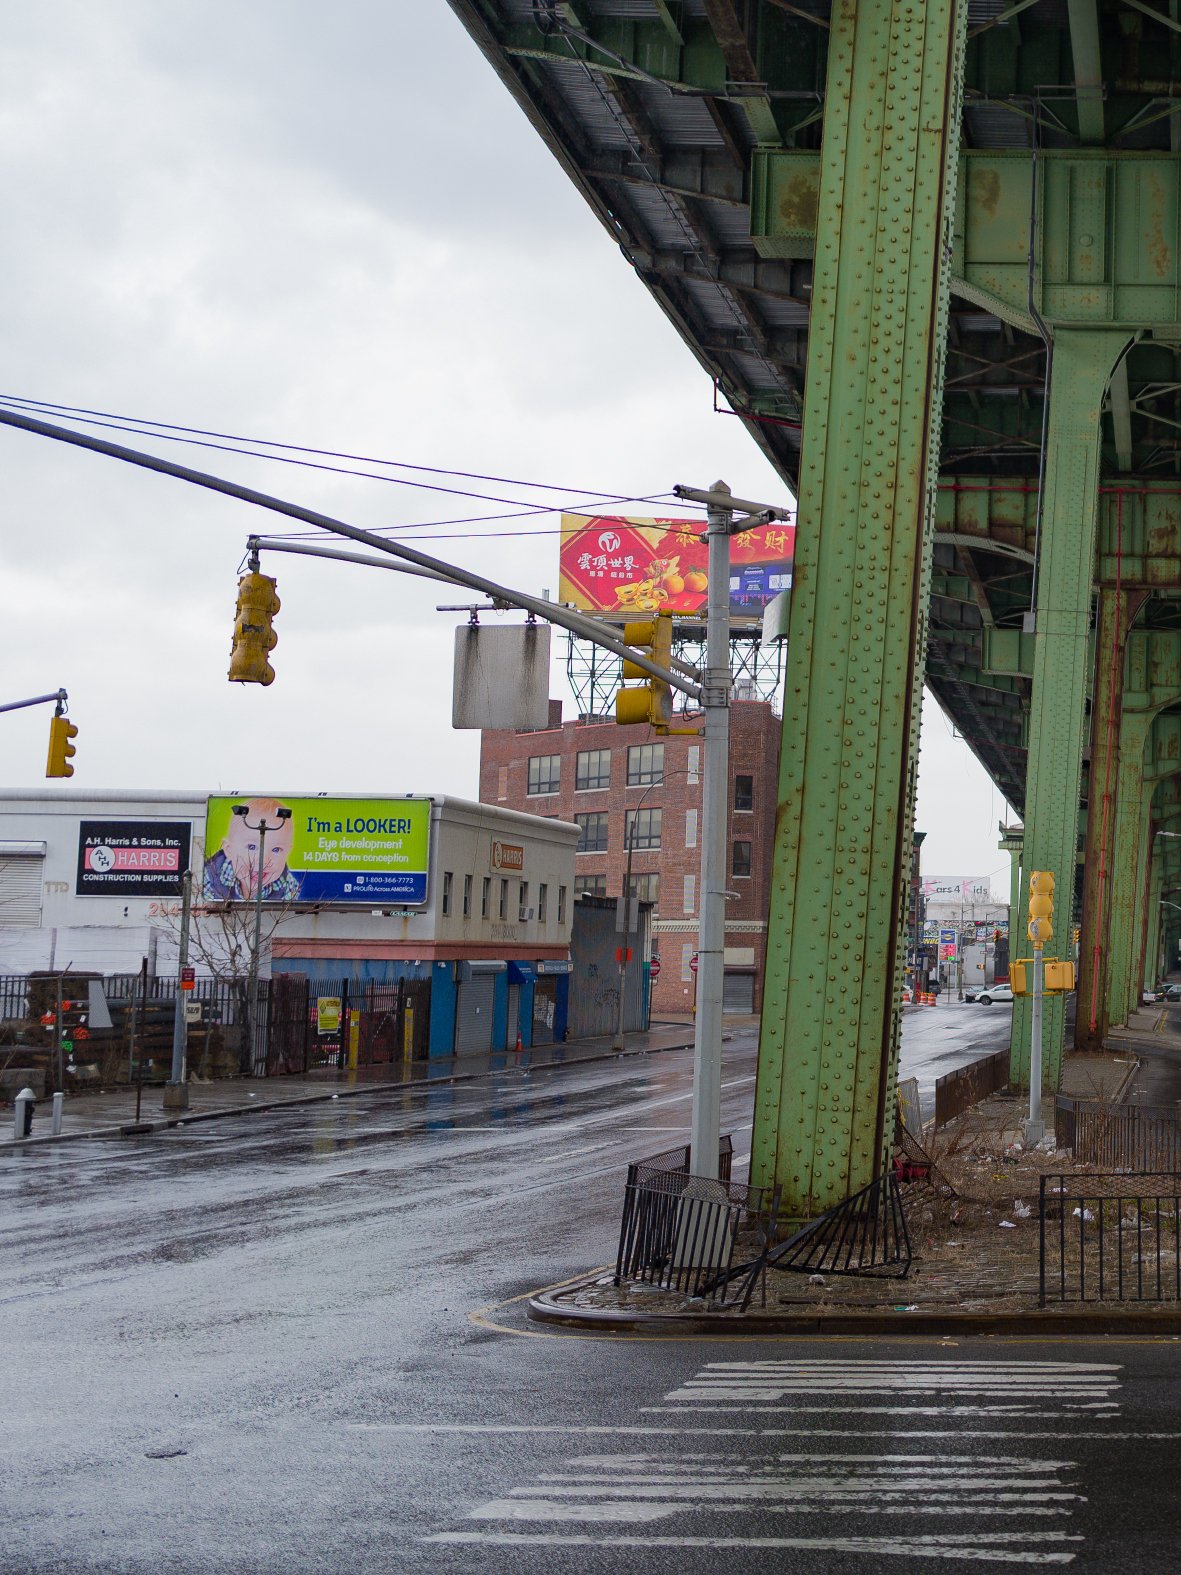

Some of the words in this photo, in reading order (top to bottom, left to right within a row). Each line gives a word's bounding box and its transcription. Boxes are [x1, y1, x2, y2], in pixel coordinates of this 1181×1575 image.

[577, 552, 640, 570] 雲頂世界
[306, 817, 331, 833] I'm
[334, 822, 343, 833] a
[346, 818, 412, 834] LOOKER!
[85, 837, 103, 845] A.H.
[104, 837, 130, 846] Harris
[131, 838, 139, 846] &
[140, 838, 164, 847] Sons,
[165, 838, 182, 846] Inc.
[318, 837, 337, 851] Eye
[339, 837, 403, 851] development
[117, 851, 177, 867] HARRIS
[303, 851, 313, 862] 14
[314, 852, 339, 862] DAYS
[341, 852, 361, 862] from
[362, 853, 409, 865] conception
[83, 874, 142, 882] CONSTRUCTION
[142, 874, 180, 882] SUPPLIES
[924, 879, 953, 897] Kars
[953, 885, 960, 894] 4
[962, 879, 988, 897] Kids
